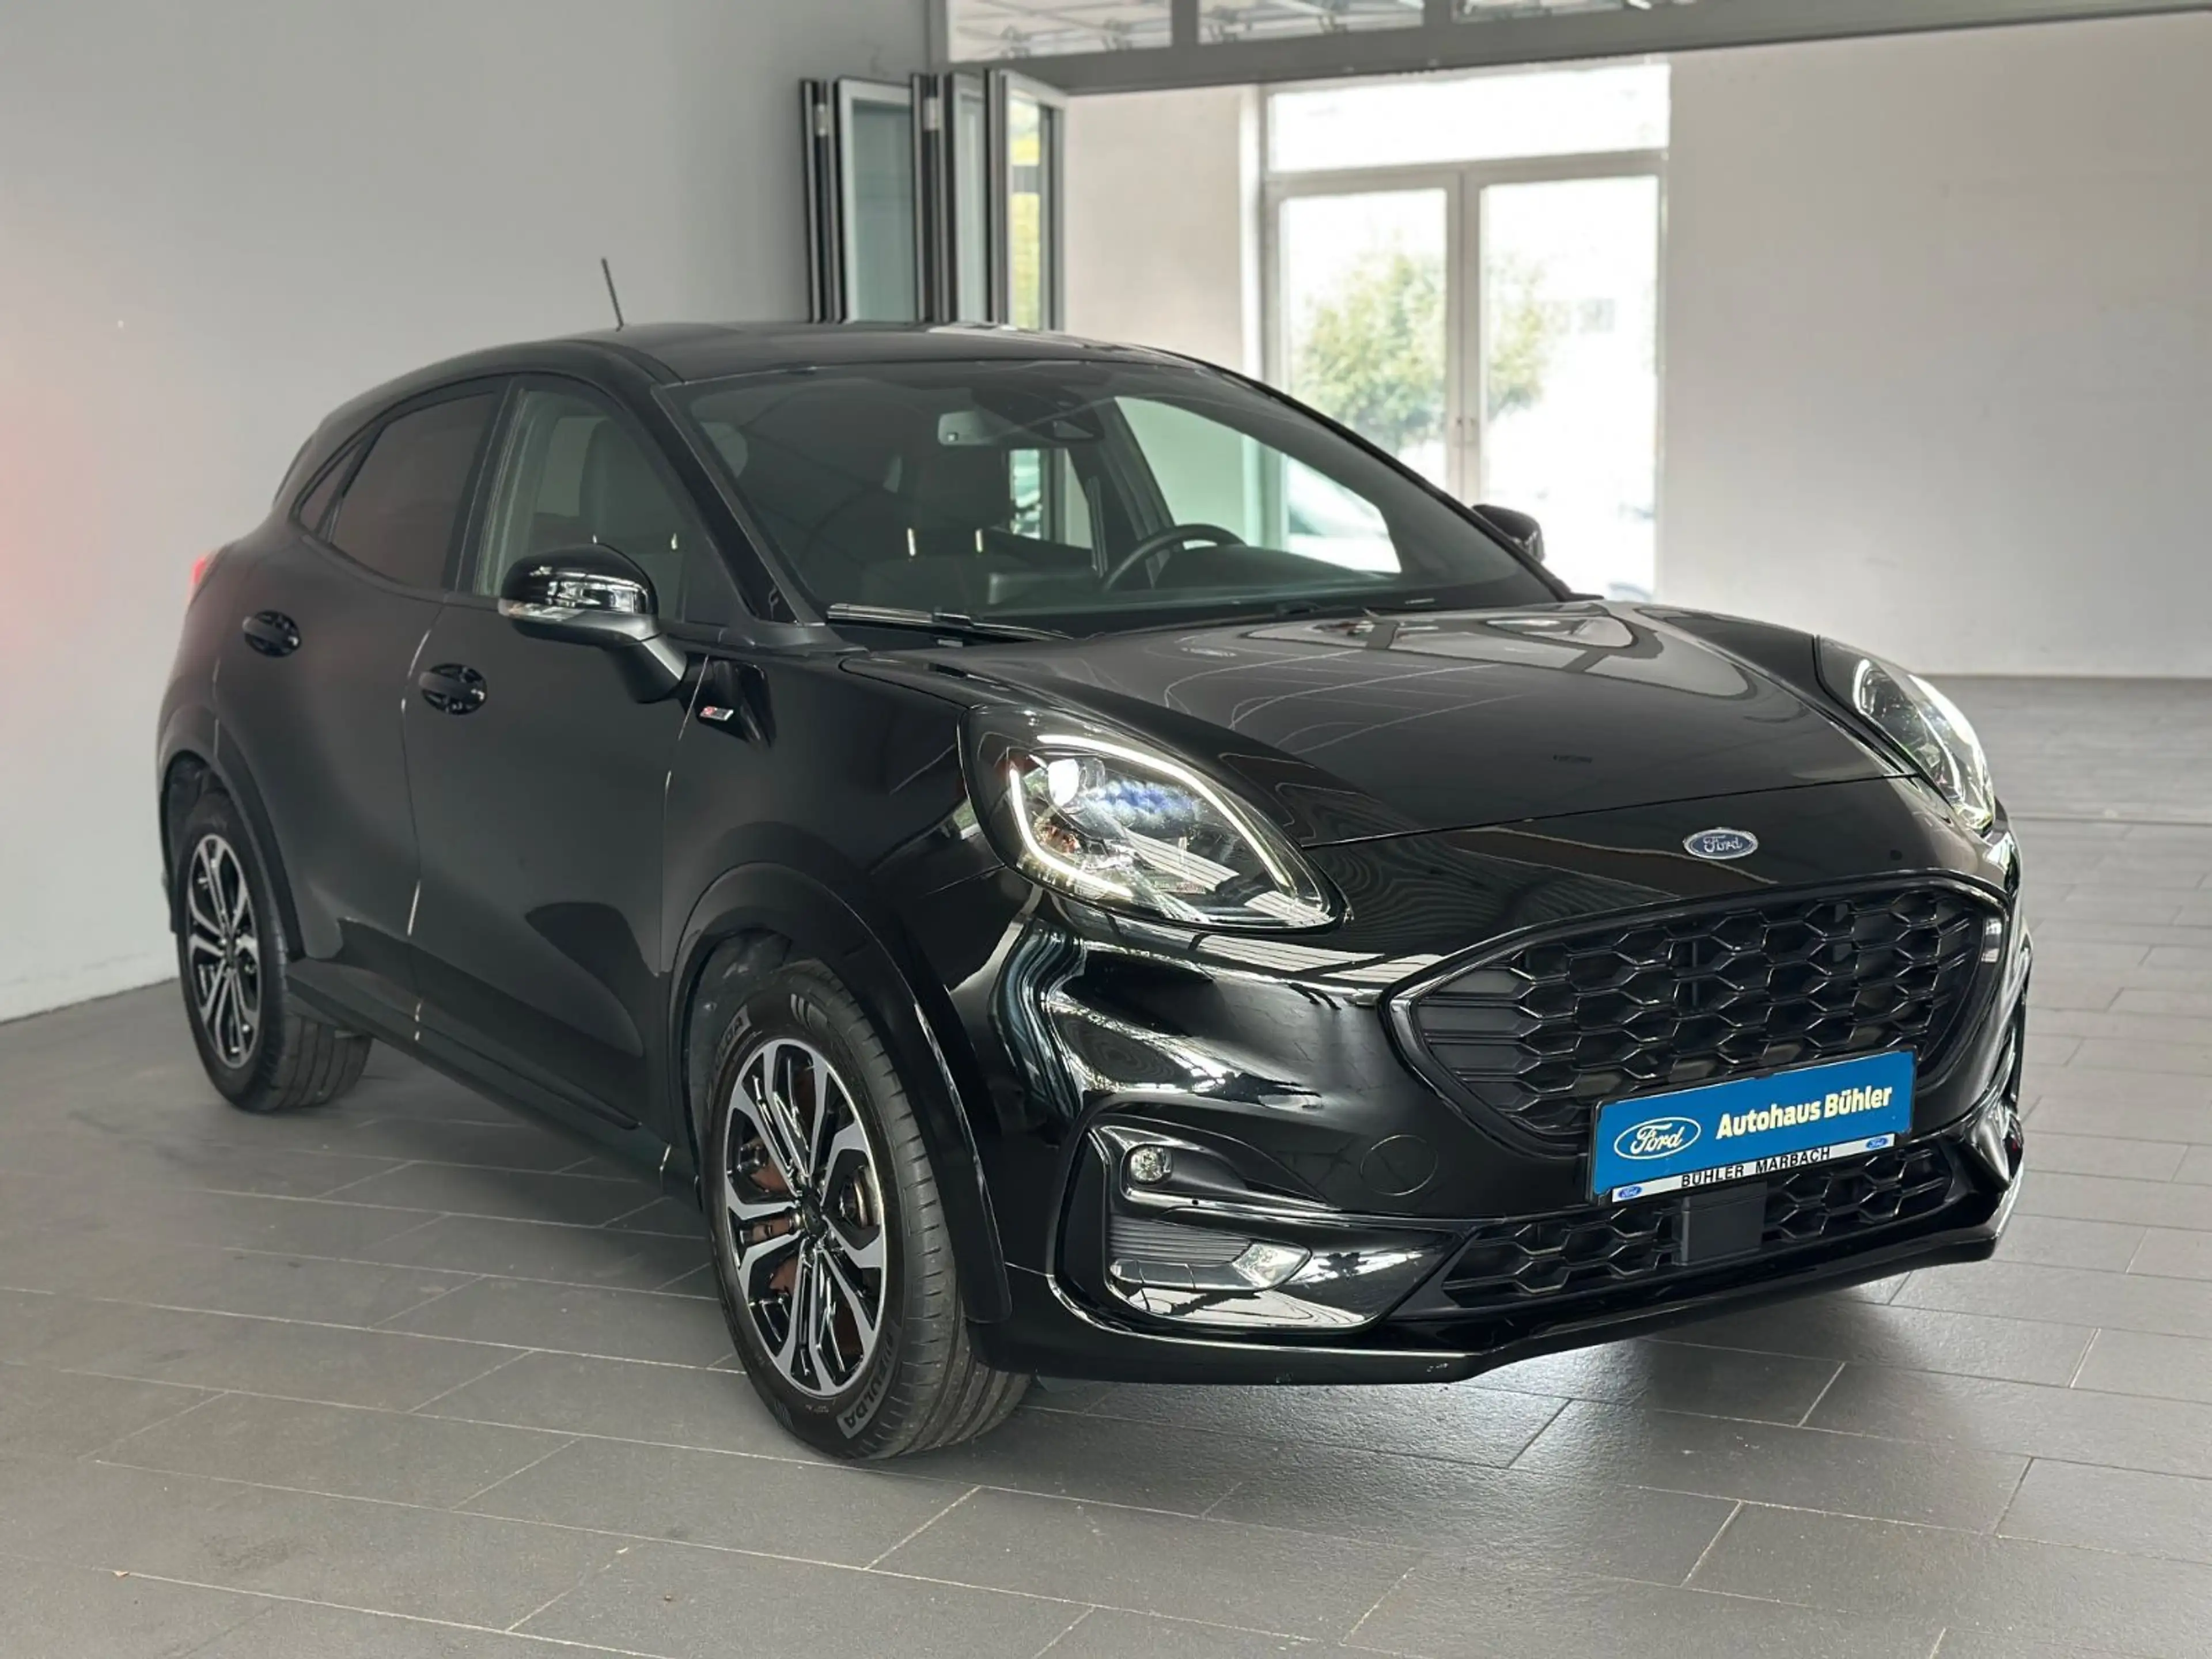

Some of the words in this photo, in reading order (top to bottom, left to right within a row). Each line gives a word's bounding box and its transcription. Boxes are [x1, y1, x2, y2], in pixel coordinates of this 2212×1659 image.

[1703, 835, 1742, 853] Ford
[1715, 1103, 1821, 1140] Autohaus
[1824, 1085, 1892, 1119] Bühler
[1630, 1123, 1685, 1155] Ford
[1756, 1146, 1831, 1174] MARBACH
